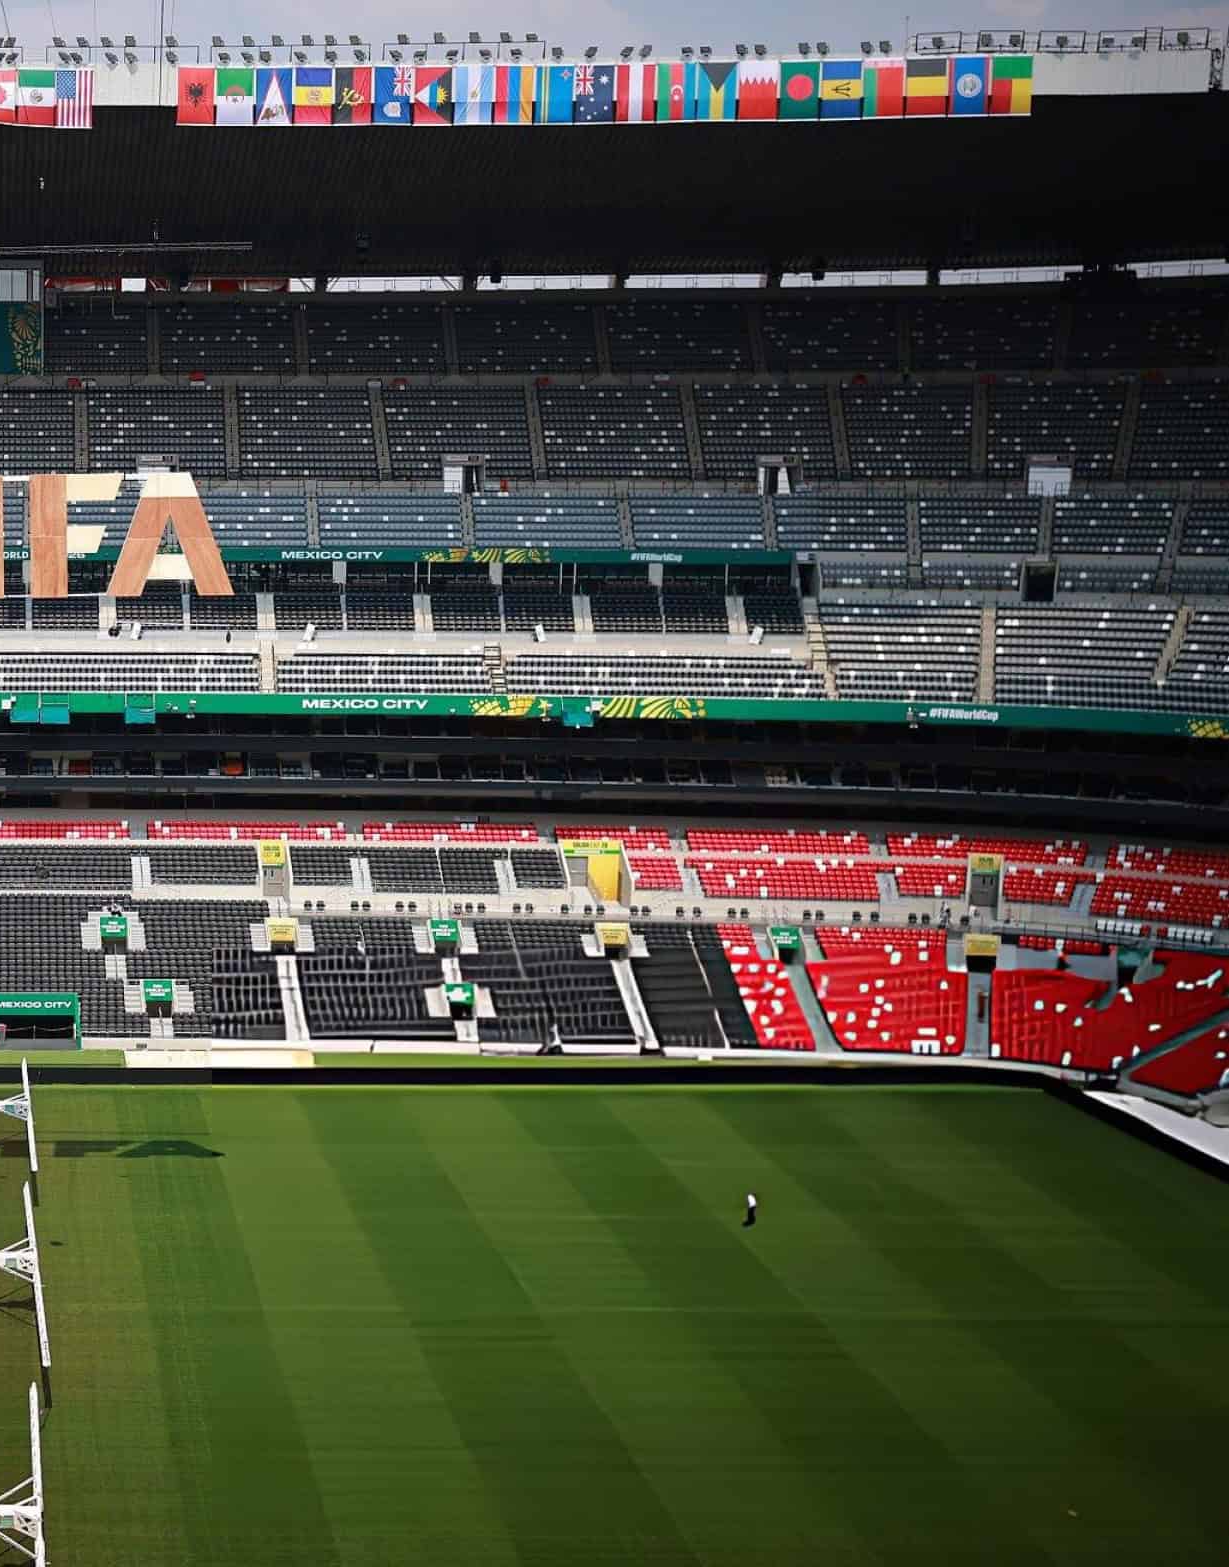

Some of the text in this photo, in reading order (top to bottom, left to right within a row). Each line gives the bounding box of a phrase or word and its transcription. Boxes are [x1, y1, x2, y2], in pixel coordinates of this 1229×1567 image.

[3, 551, 29, 559] ORLD
[281, 551, 384, 560] MEXICO CITY
[302, 698, 429, 710] MEXICO CITY
[43, 1000, 72, 1009] CITY
